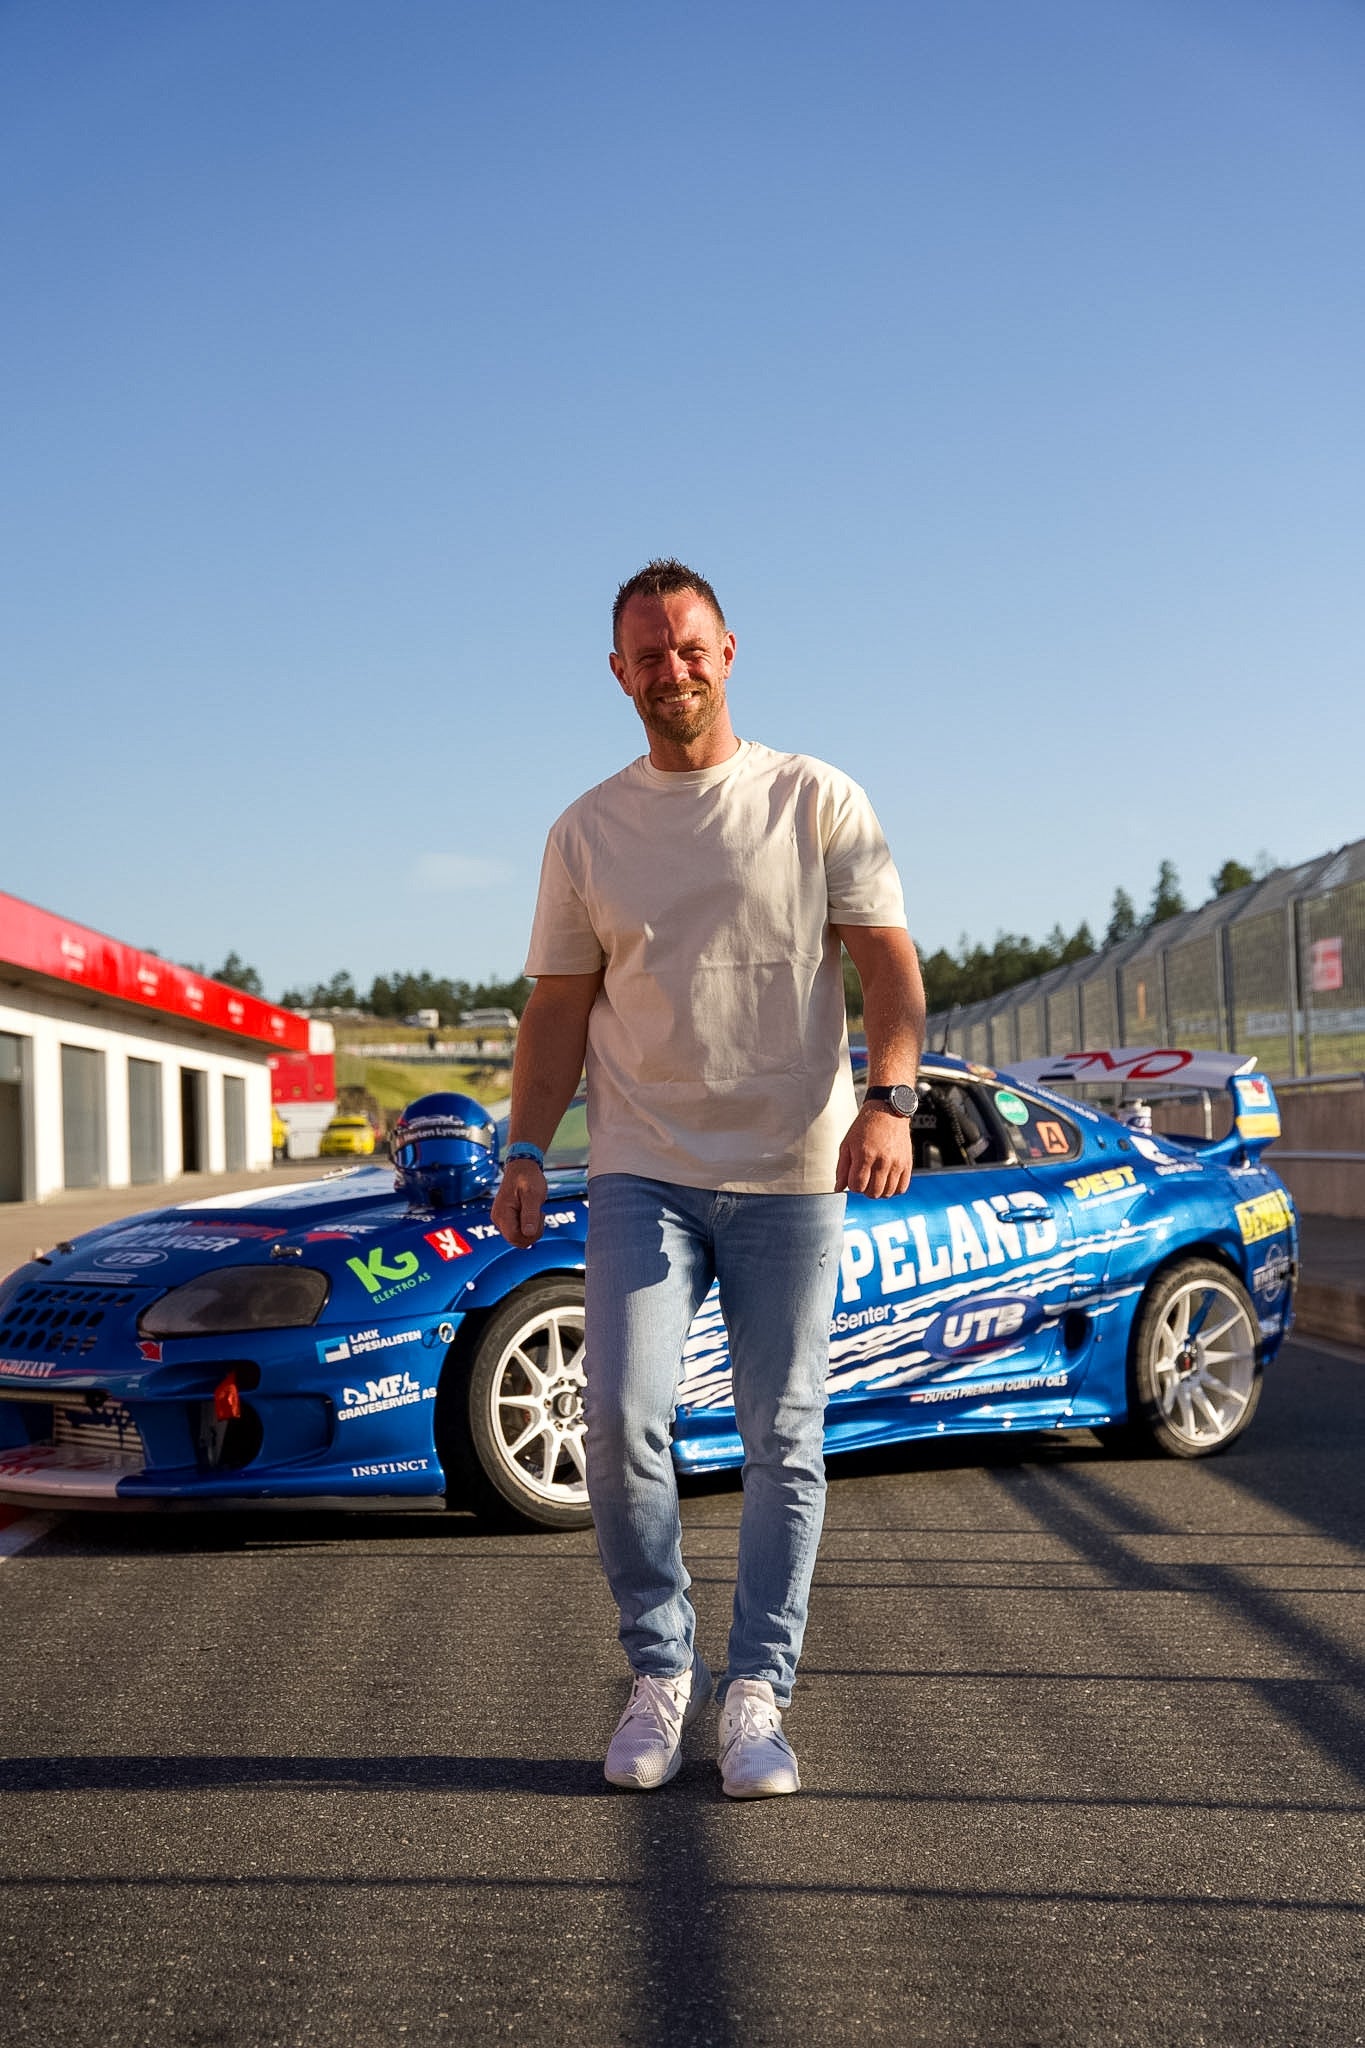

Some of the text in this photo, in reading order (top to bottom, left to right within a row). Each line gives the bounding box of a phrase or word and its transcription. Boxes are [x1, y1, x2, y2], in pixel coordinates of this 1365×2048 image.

[1046, 1126, 1064, 1146] A
[103, 1252, 161, 1265] UTB
[840, 1191, 1058, 1304] PELAND
[372, 1272, 431, 1304] ELEKTRO AS
[829, 1304, 892, 1335] aSenter
[942, 1302, 1026, 1348] UTB
[349, 1329, 380, 1344] LAKK
[351, 1329, 422, 1355] SPESIALISTEN
[923, 1374, 1068, 1403] DUTCH PREMIUM QUALITY OILS
[337, 1387, 437, 1421] GRAVESERVICE AS
[351, 1459, 428, 1478] INSTINCT
